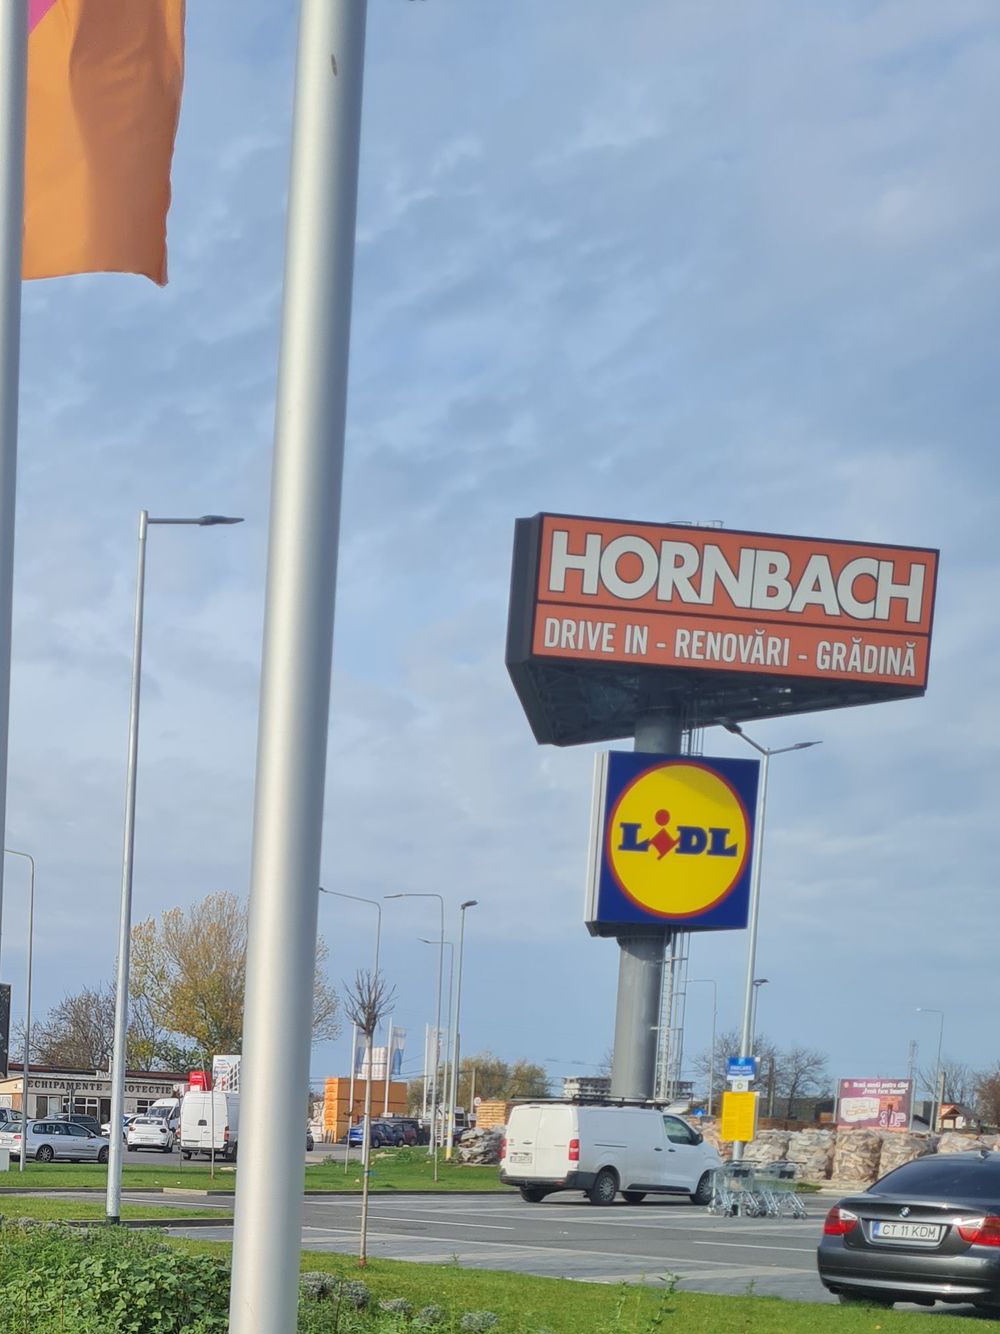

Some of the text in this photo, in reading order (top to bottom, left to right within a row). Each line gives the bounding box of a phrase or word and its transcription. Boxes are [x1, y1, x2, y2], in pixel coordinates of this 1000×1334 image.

[548, 529, 926, 624] HORNBACH
[543, 617, 617, 653] DRIVE
[623, 623, 649, 656] IN
[674, 628, 790, 667] RENOVĂRI
[816, 636, 917, 677] GRĂDINĂ
[617, 808, 738, 860] LIDL
[27, 1080, 103, 1091] ECHIPAMENTE
[124, 1084, 172, 1095] OTECTIE
[882, 1224, 936, 1238] CT 11 KDM
